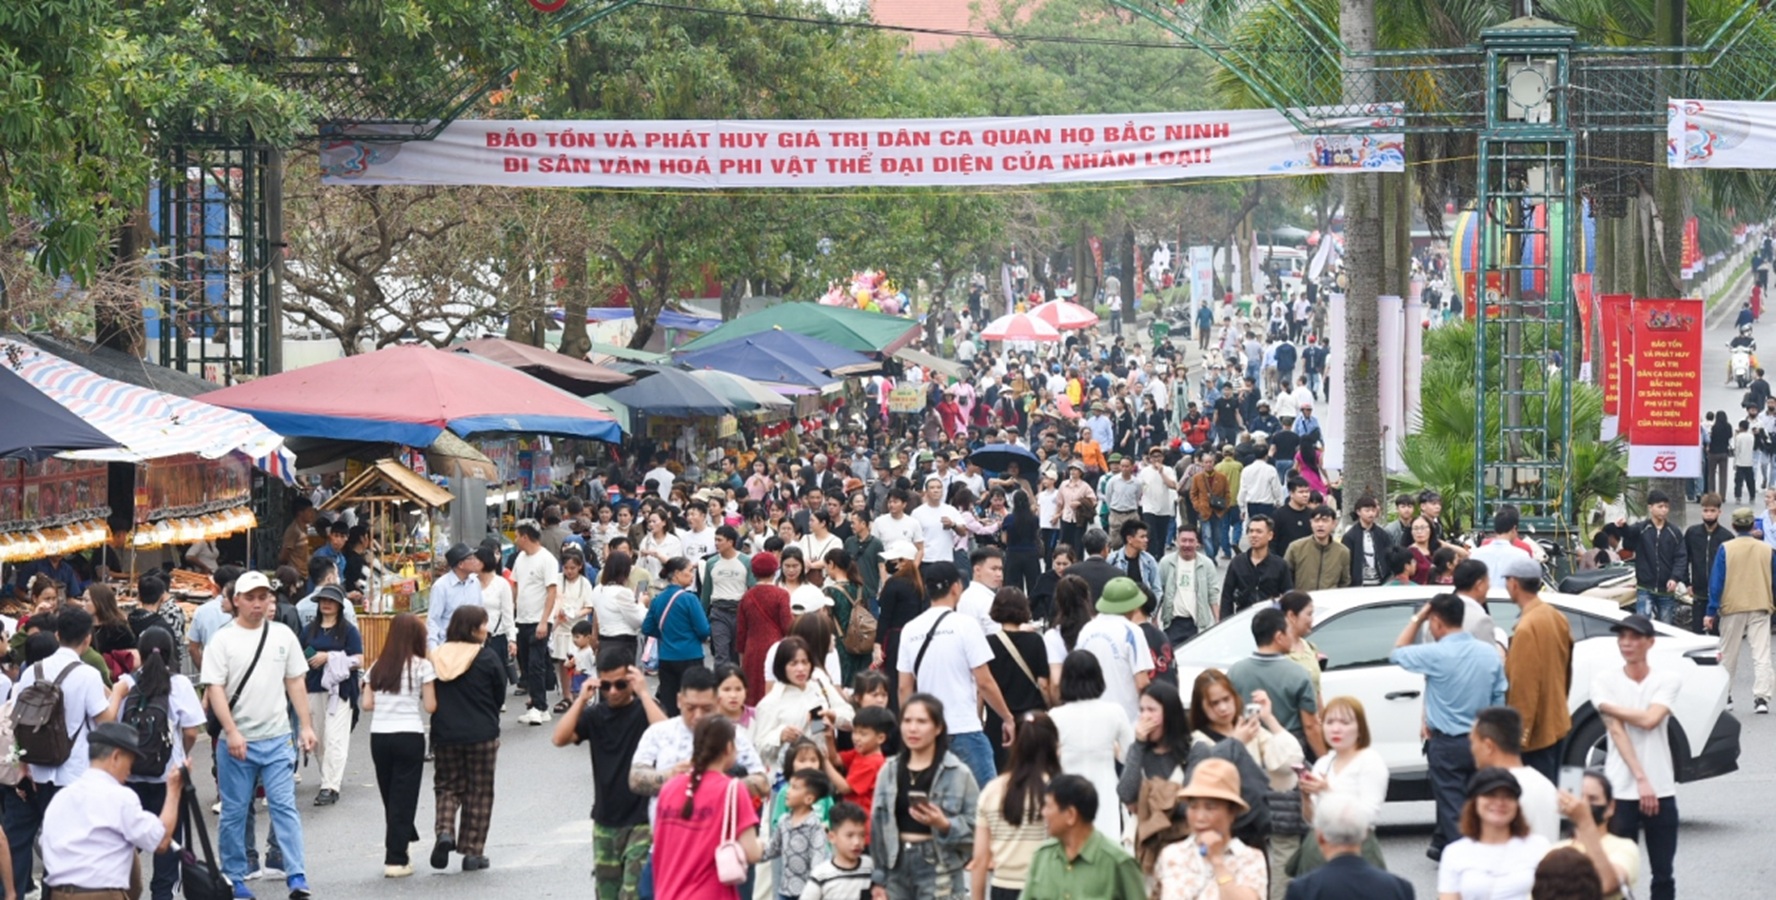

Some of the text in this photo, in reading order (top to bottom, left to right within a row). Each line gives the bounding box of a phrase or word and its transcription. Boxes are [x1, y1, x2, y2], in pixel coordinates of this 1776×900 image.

[486, 127, 538, 148] BẢO
[604, 128, 638, 148] VÀ
[645, 128, 710, 149] PHÁT
[719, 132, 769, 149] HUY
[777, 128, 821, 149] GIÁ
[830, 131, 869, 151] TRỊ
[877, 128, 932, 148] DÂN
[939, 129, 974, 147] CA
[982, 128, 1053, 147] QUAN
[1060, 127, 1096, 146] HỌ
[1103, 120, 1156, 143] BẮC
[1165, 123, 1230, 141] NINH
[538, 153, 592, 174] SẢN
[599, 155, 652, 174] VĂN
[659, 156, 711, 174] HOÁ
[719, 158, 763, 174] PHI
[771, 155, 816, 177] VẬT
[827, 152, 873, 174] THỂ
[880, 157, 925, 177] ĐẠI
[932, 153, 994, 176] DIỆN
[1002, 152, 1055, 172] CỦA
[1062, 149, 1137, 170] NHÂN
[1653, 456, 1677, 472] 5G
